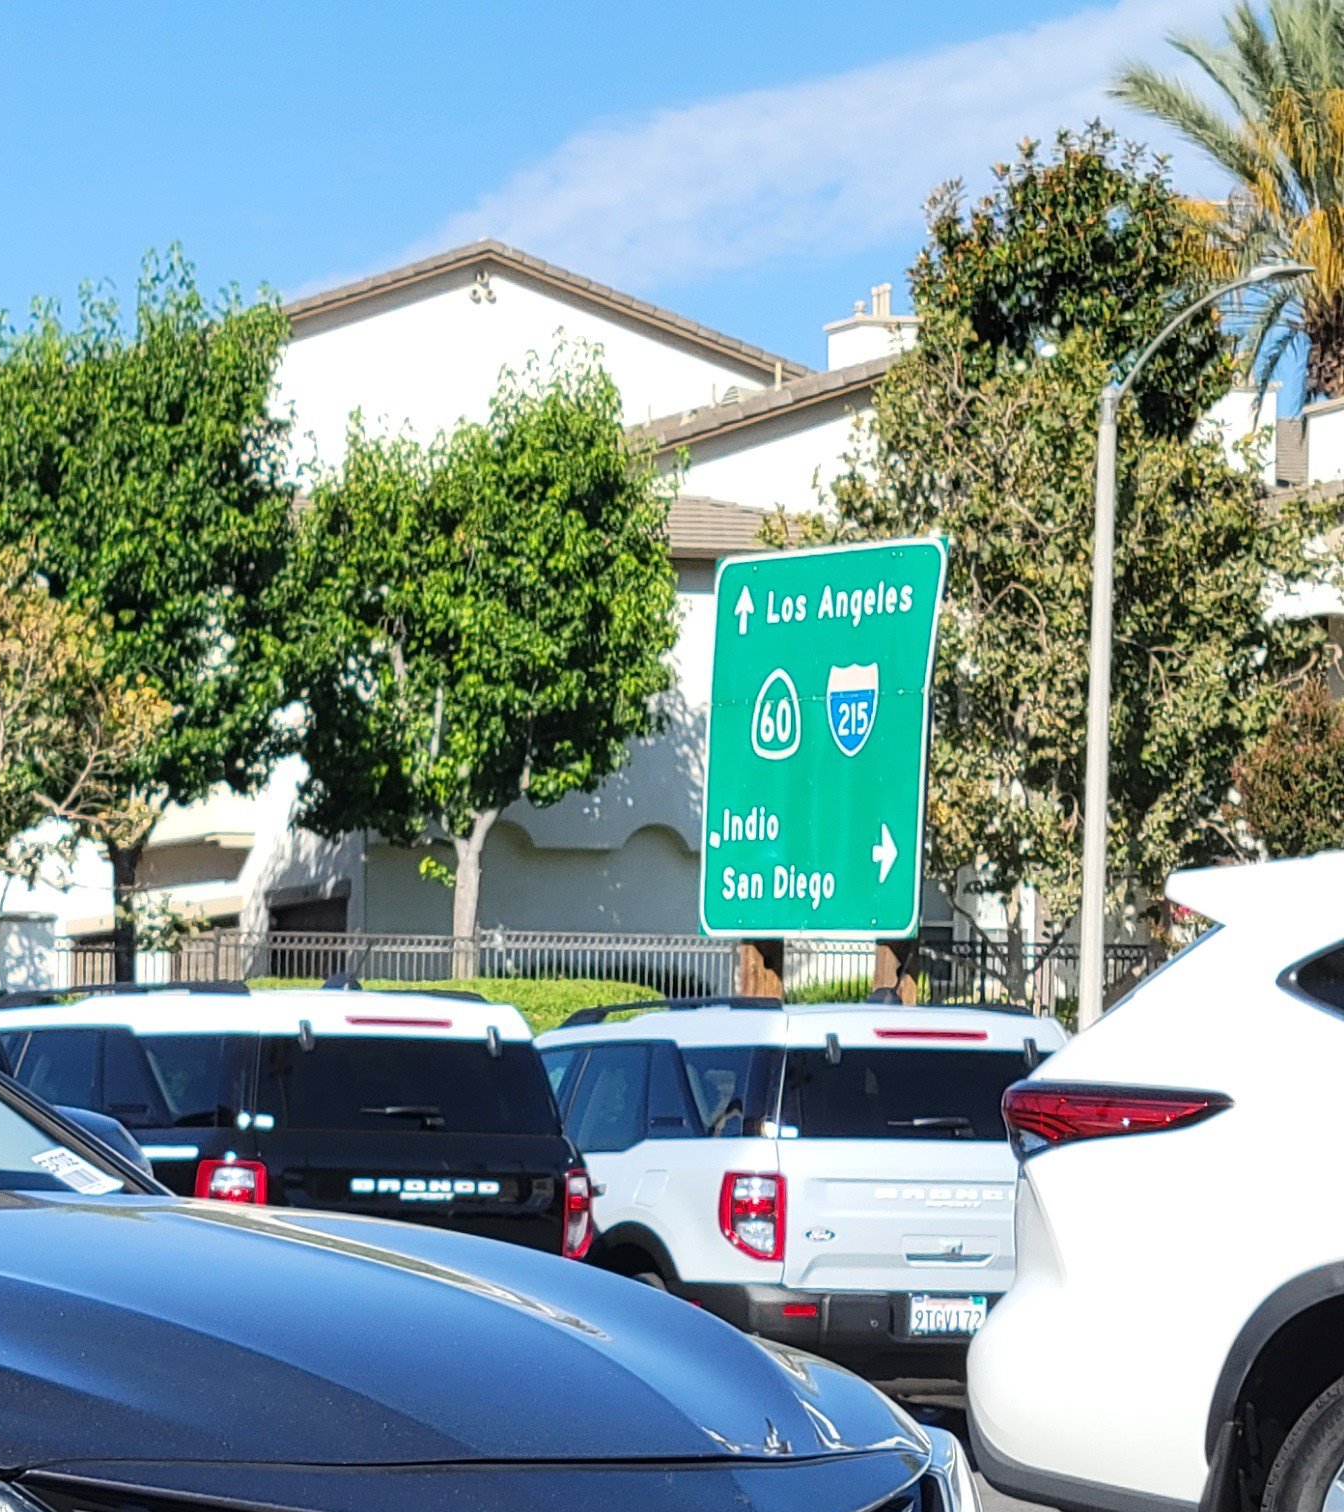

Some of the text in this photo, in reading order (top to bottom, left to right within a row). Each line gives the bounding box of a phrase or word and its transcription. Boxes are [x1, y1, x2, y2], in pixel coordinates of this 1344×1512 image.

[766, 581, 913, 627] Los Angeles
[759, 699, 792, 743] 60
[837, 701, 869, 737] 215
[722, 807, 779, 842] Indio
[721, 865, 835, 909] San Diego
[915, 1309, 982, 1333] 9TGV172
